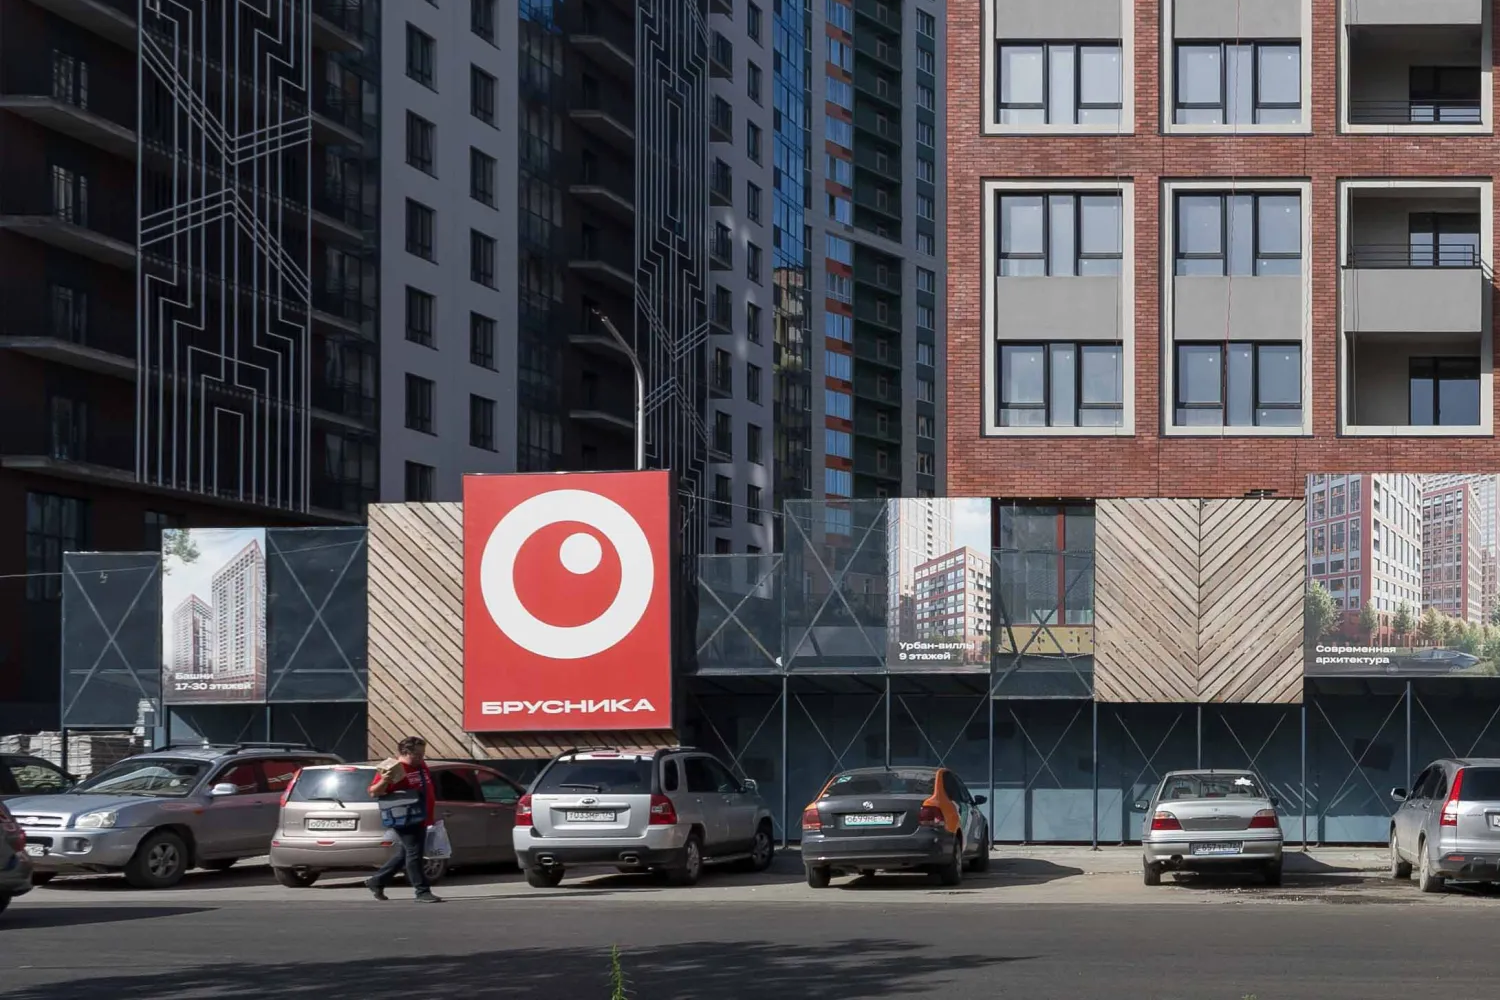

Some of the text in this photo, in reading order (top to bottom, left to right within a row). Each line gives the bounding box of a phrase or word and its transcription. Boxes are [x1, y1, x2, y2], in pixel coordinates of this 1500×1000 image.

[899, 641, 975, 651] Урбан-виллы
[1315, 645, 1397, 655] Современная
[908, 651, 951, 660] этажей
[1315, 656, 1390, 665] архитектура
[174, 672, 214, 680] Башни
[174, 682, 253, 691] 17-30 этажей
[481, 698, 656, 715] БРУСНИКА
